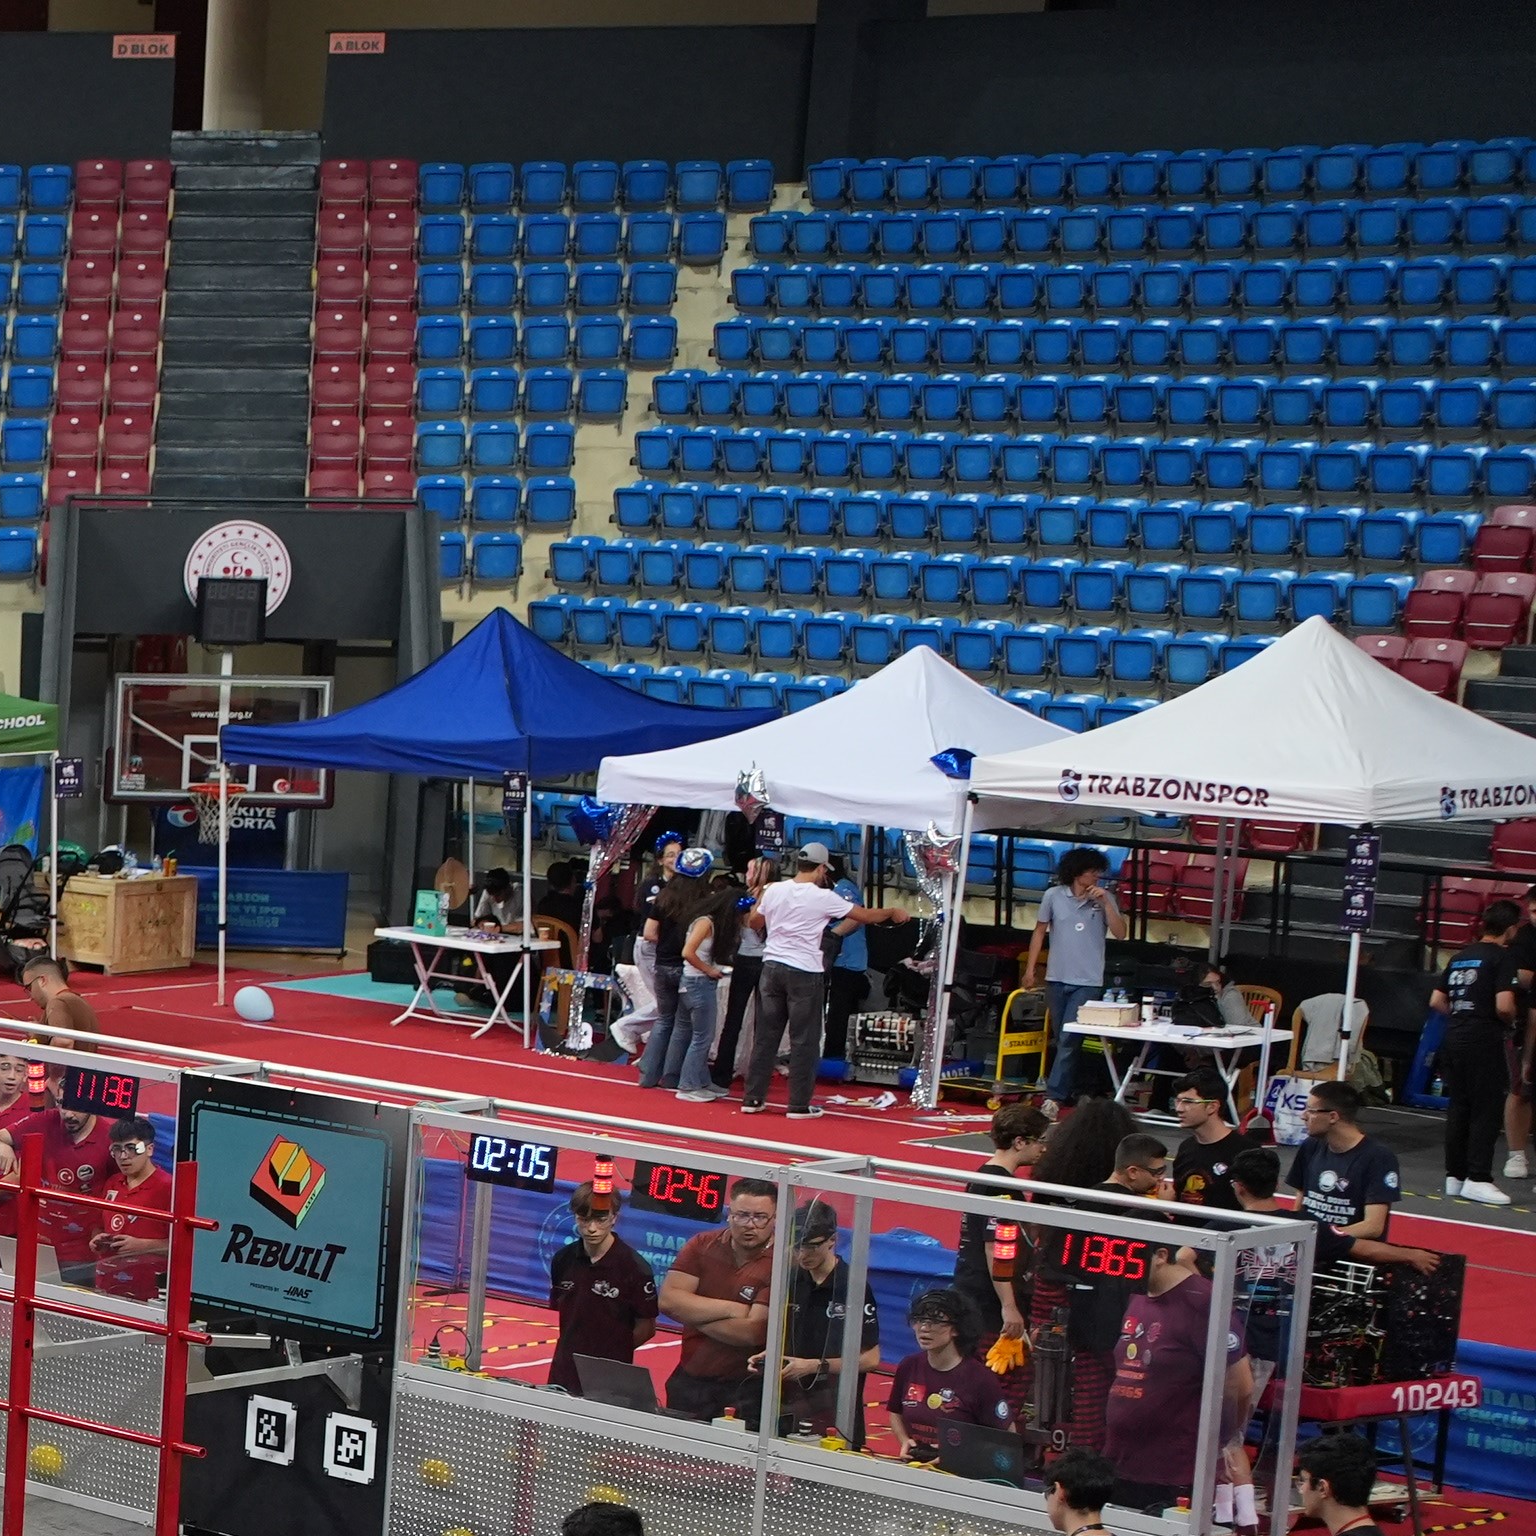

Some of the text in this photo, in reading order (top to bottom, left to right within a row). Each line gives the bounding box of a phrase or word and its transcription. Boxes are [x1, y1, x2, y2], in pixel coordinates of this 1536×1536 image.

[119, 44, 171, 56] D BLOK
[333, 42, 379, 52] A BLOK
[1087, 775, 1270, 809] TRABZONSPOR
[1009, 1039, 1038, 1049] STANLEY
[472, 1135, 551, 1180] 02:05
[648, 1165, 720, 1210] 10246
[220, 1223, 348, 1284] REBUILT
[1061, 1233, 1146, 1281] 11365
[1391, 1380, 1478, 1413] 10243
